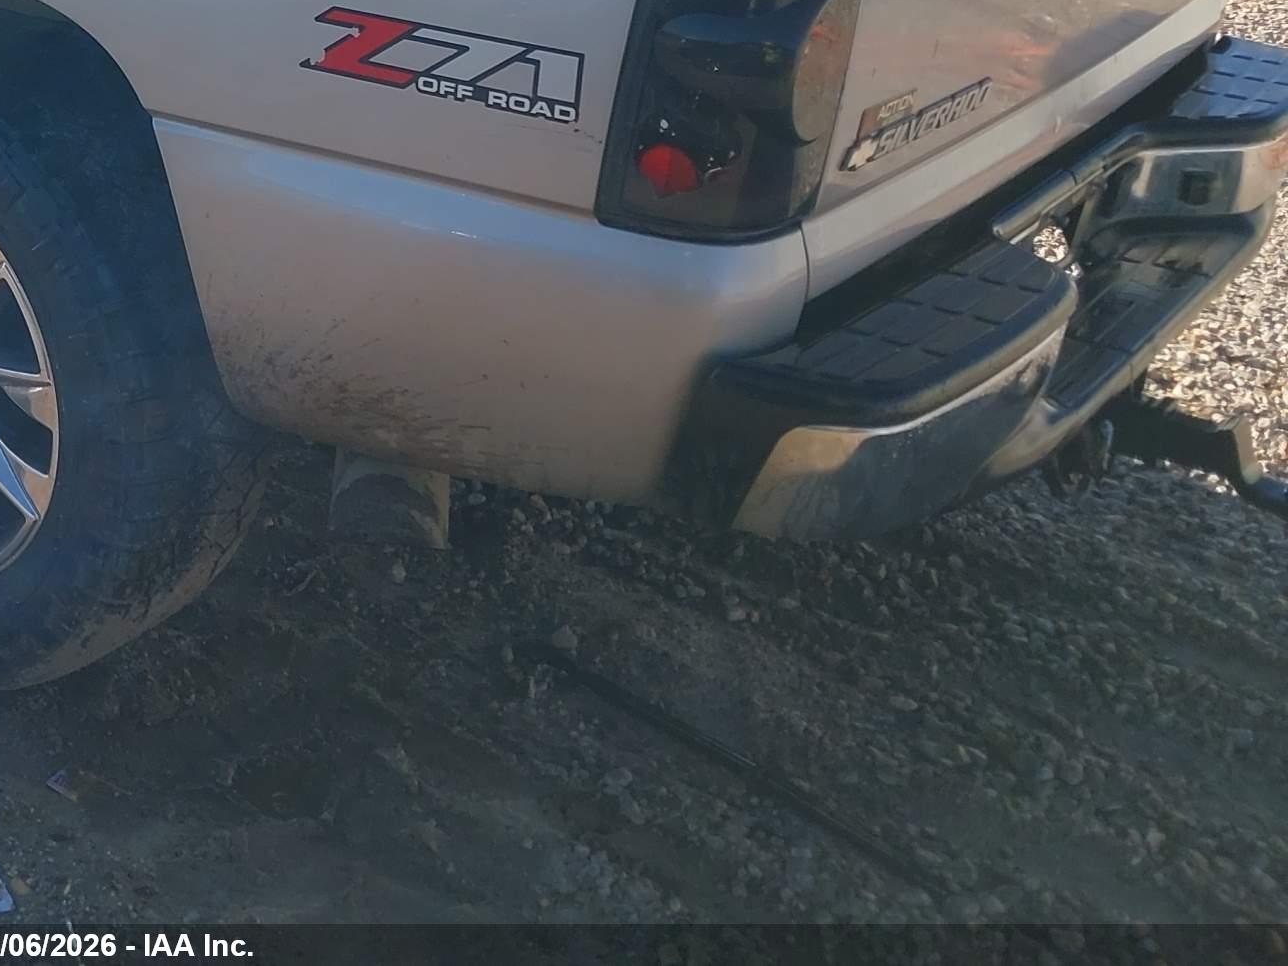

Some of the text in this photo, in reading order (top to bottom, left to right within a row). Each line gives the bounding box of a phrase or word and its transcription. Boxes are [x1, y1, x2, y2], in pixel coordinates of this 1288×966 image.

[299, 5, 585, 104] Z71
[416, 75, 578, 123] OFF ROAD
[873, 84, 992, 156] SILVERADO
